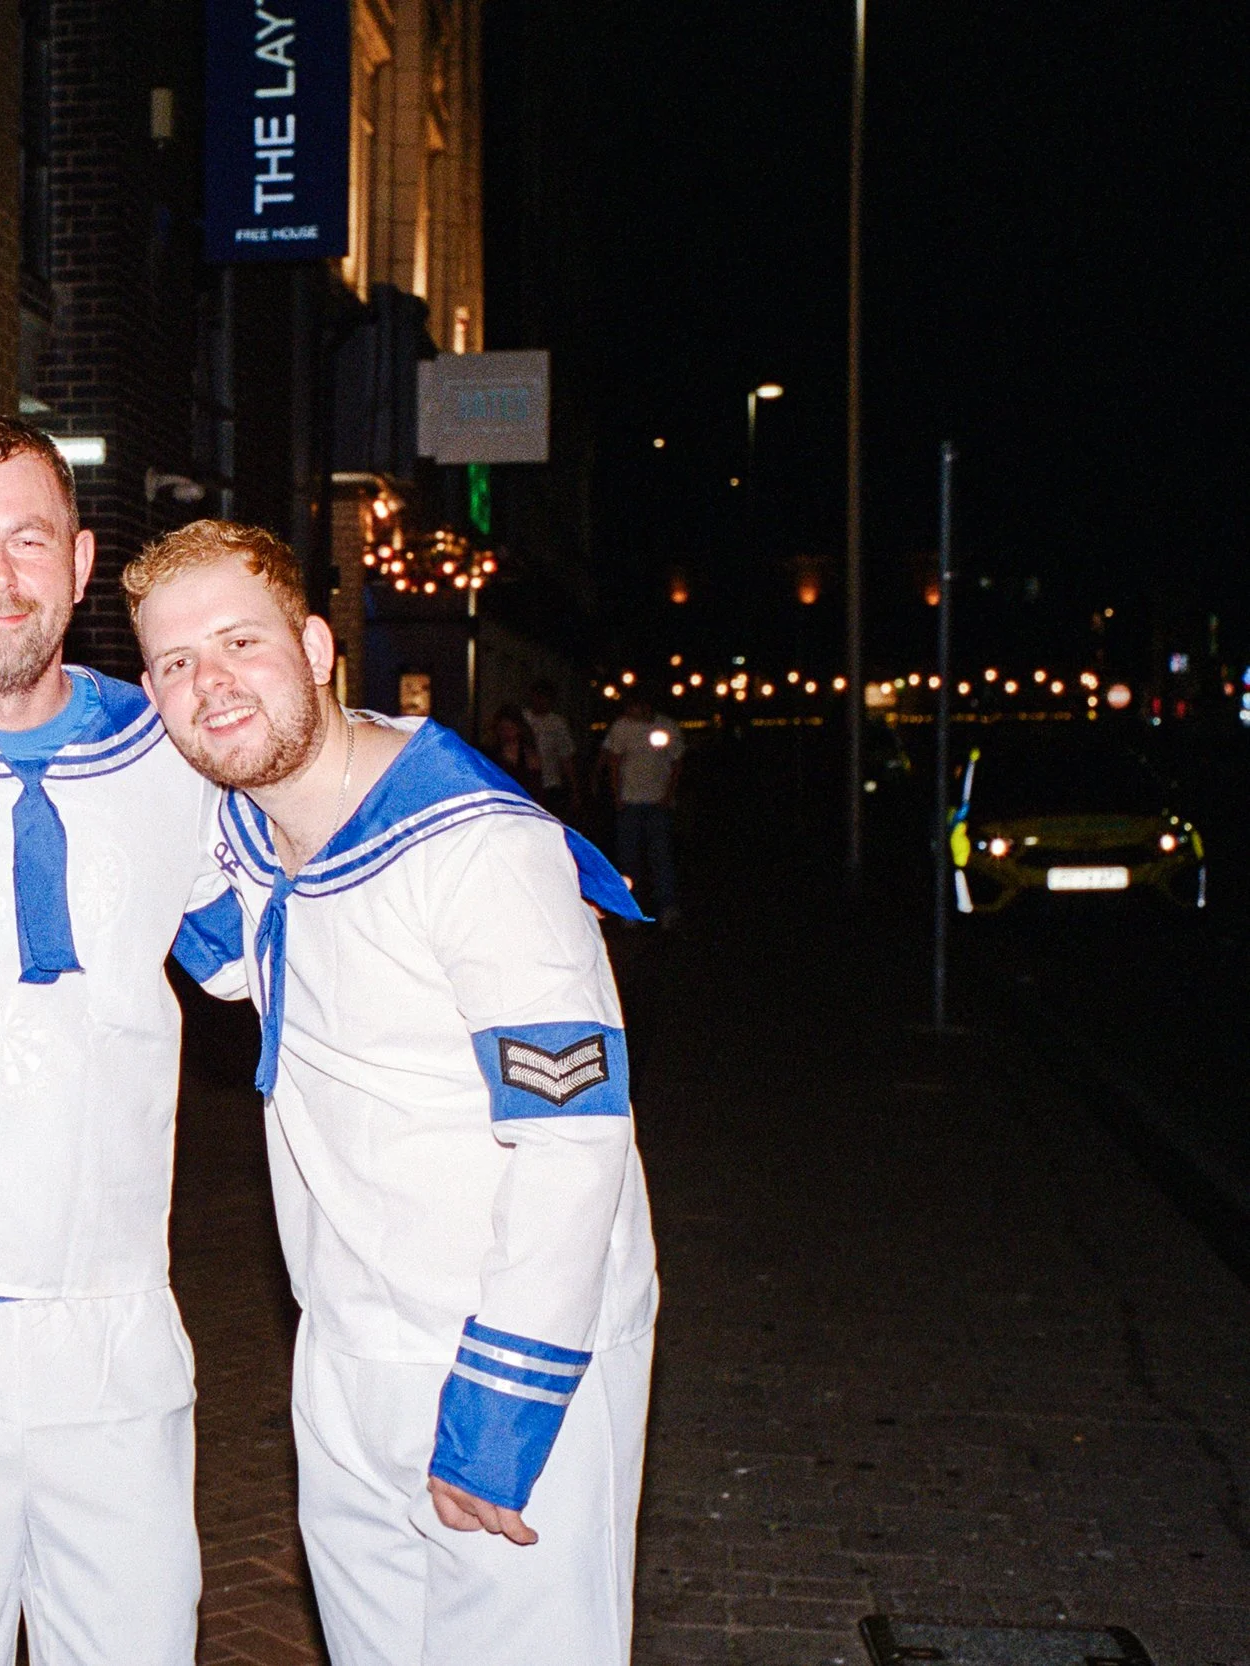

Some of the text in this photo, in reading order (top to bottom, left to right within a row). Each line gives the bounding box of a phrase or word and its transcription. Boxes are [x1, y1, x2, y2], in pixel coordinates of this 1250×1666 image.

[255, 0, 295, 214] THE LAY
[236, 226, 317, 241] FREE HOUSE
